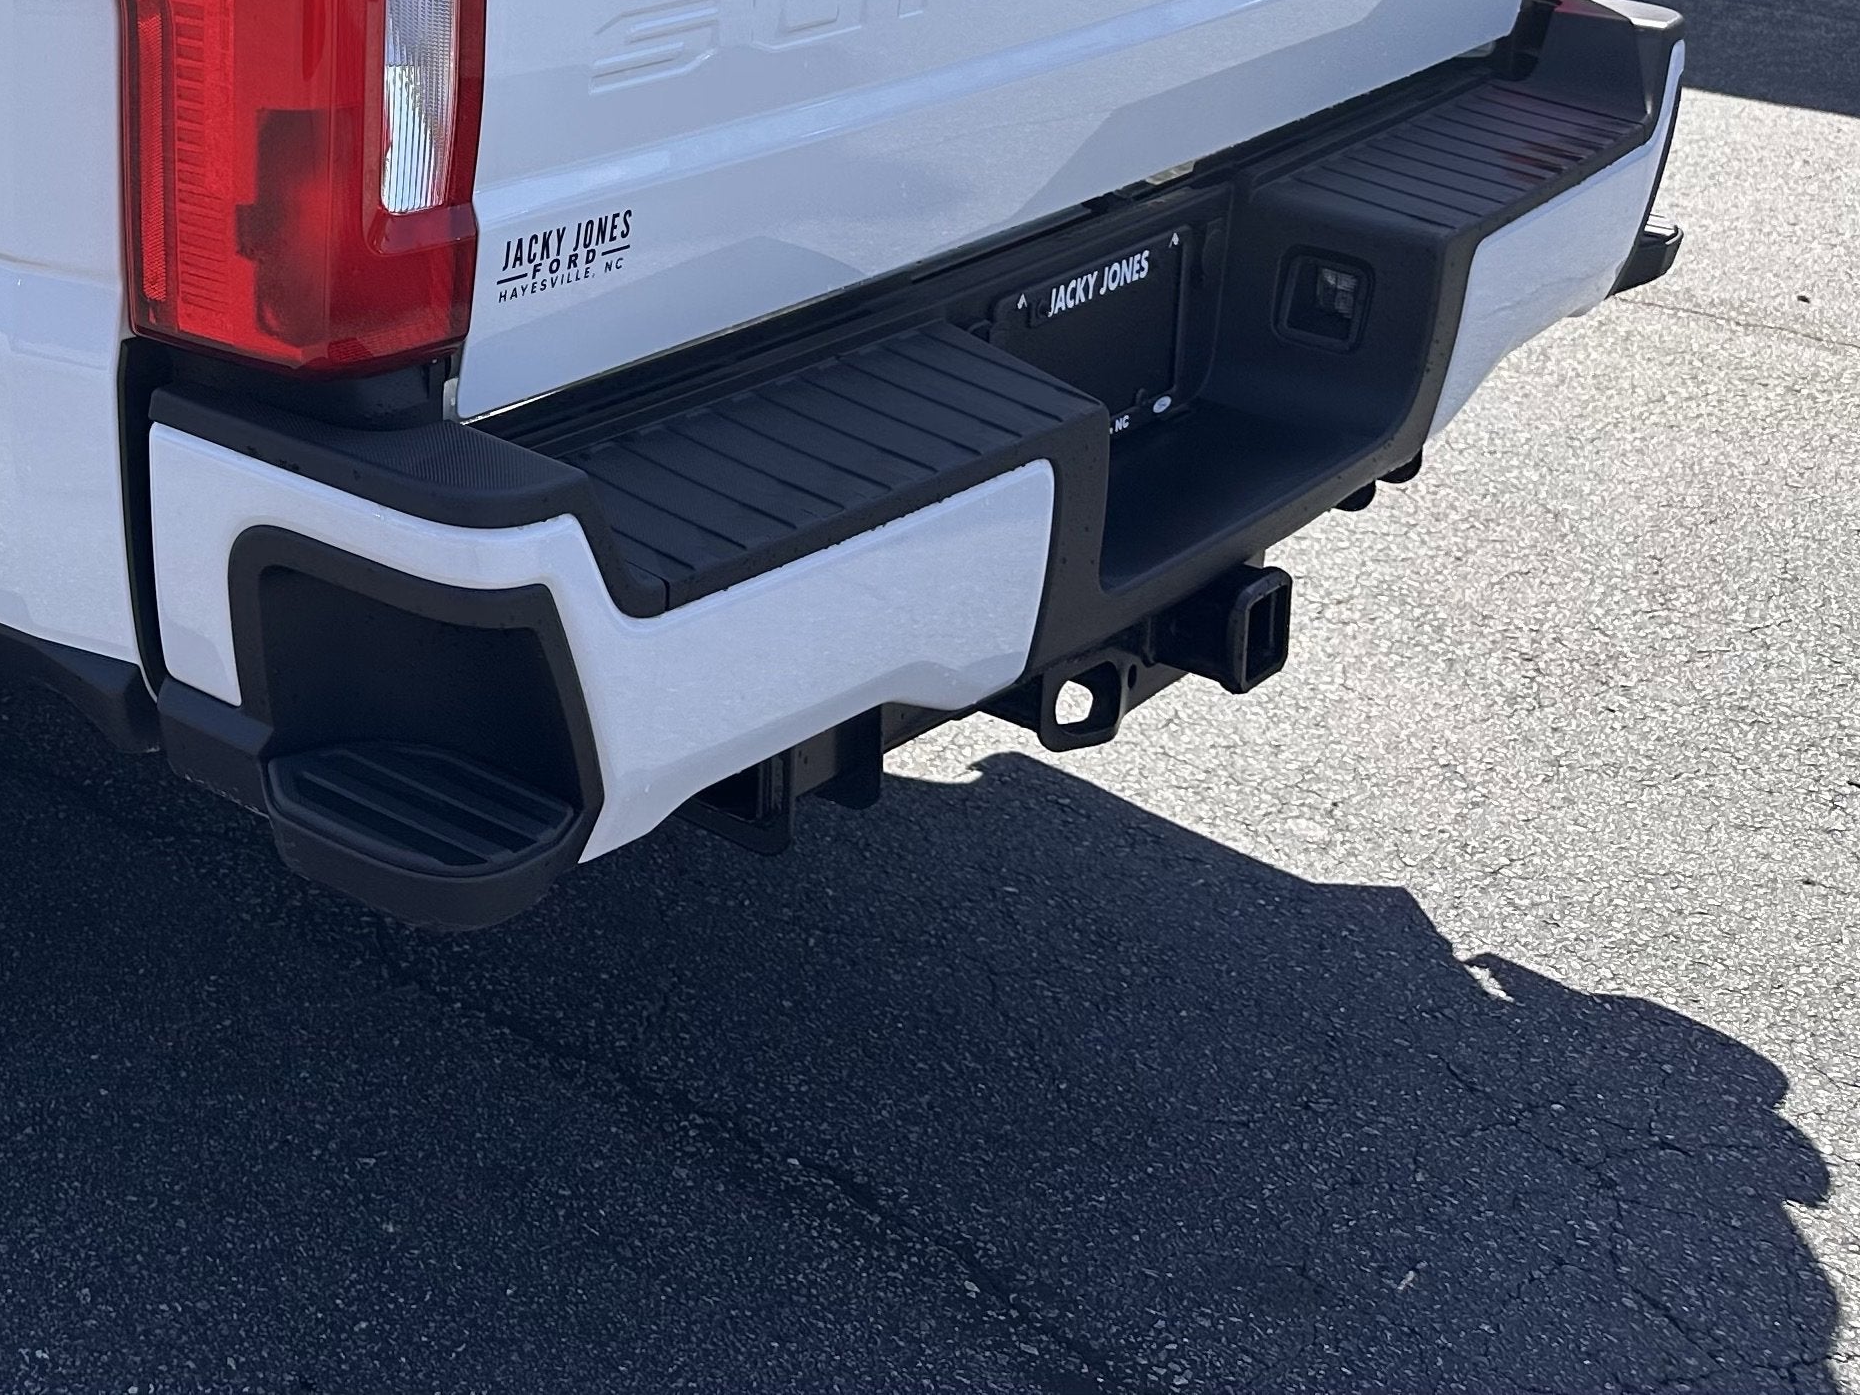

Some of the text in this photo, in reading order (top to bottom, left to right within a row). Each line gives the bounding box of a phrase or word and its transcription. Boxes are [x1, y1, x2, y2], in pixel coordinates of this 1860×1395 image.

[502, 209, 632, 271] JACKY JONES
[531, 248, 596, 280] FORD
[604, 257, 624, 273] NC
[1048, 249, 1150, 317] JACKY JONES
[1114, 414, 1130, 433] NC
